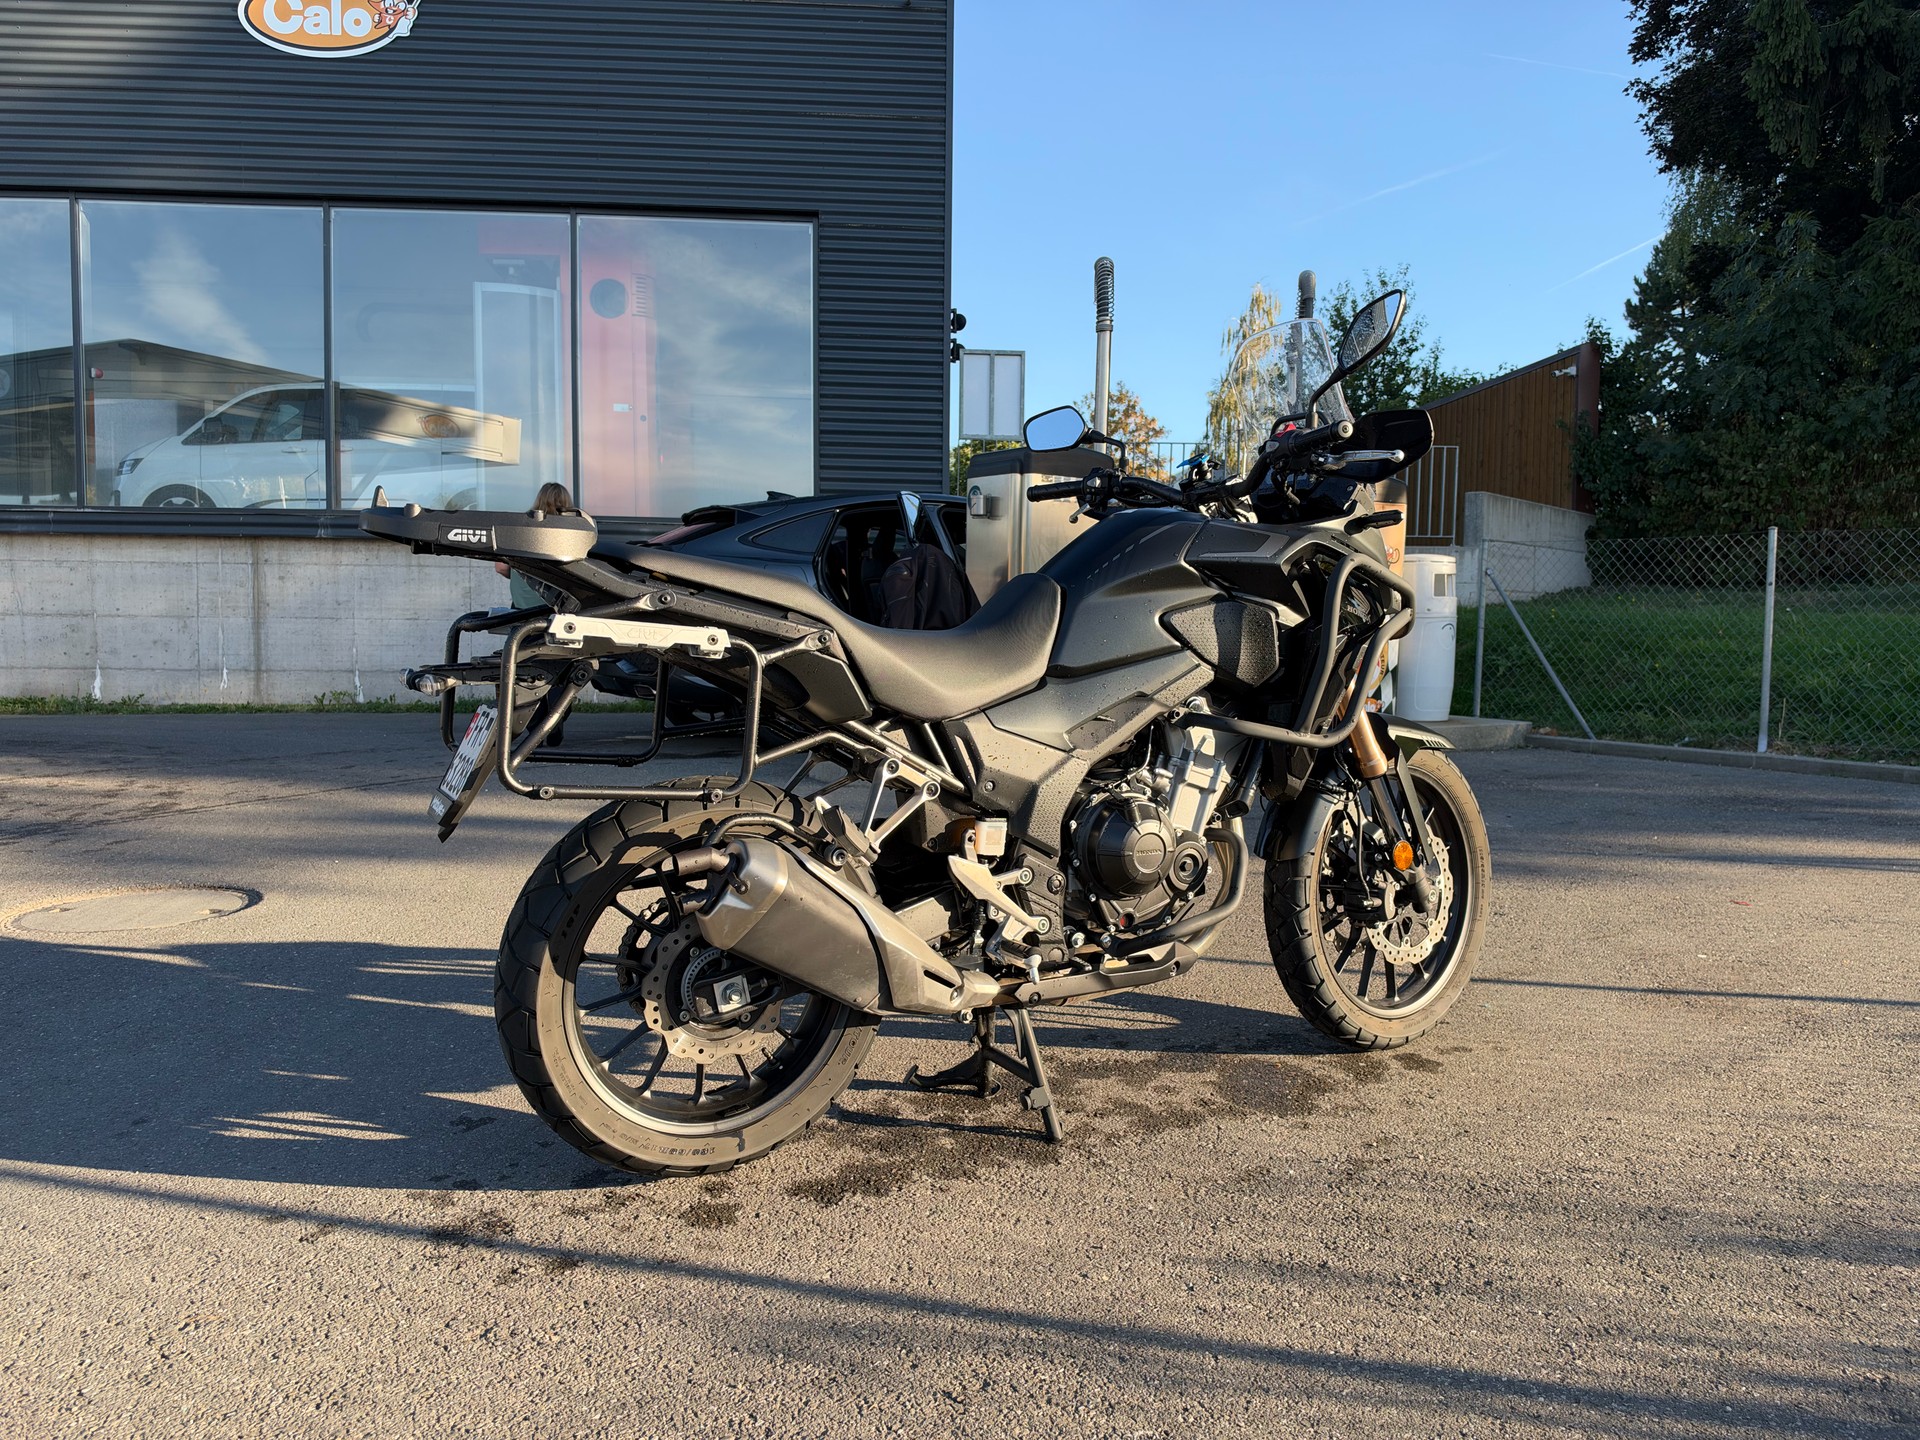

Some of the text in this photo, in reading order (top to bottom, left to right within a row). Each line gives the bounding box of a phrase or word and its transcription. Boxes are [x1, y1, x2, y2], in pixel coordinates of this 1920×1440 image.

[263, 0, 373, 37] Calo
[447, 528, 487, 543] GIVI
[467, 711, 491, 748] FR
[1136, 848, 1162, 856] HONDA
